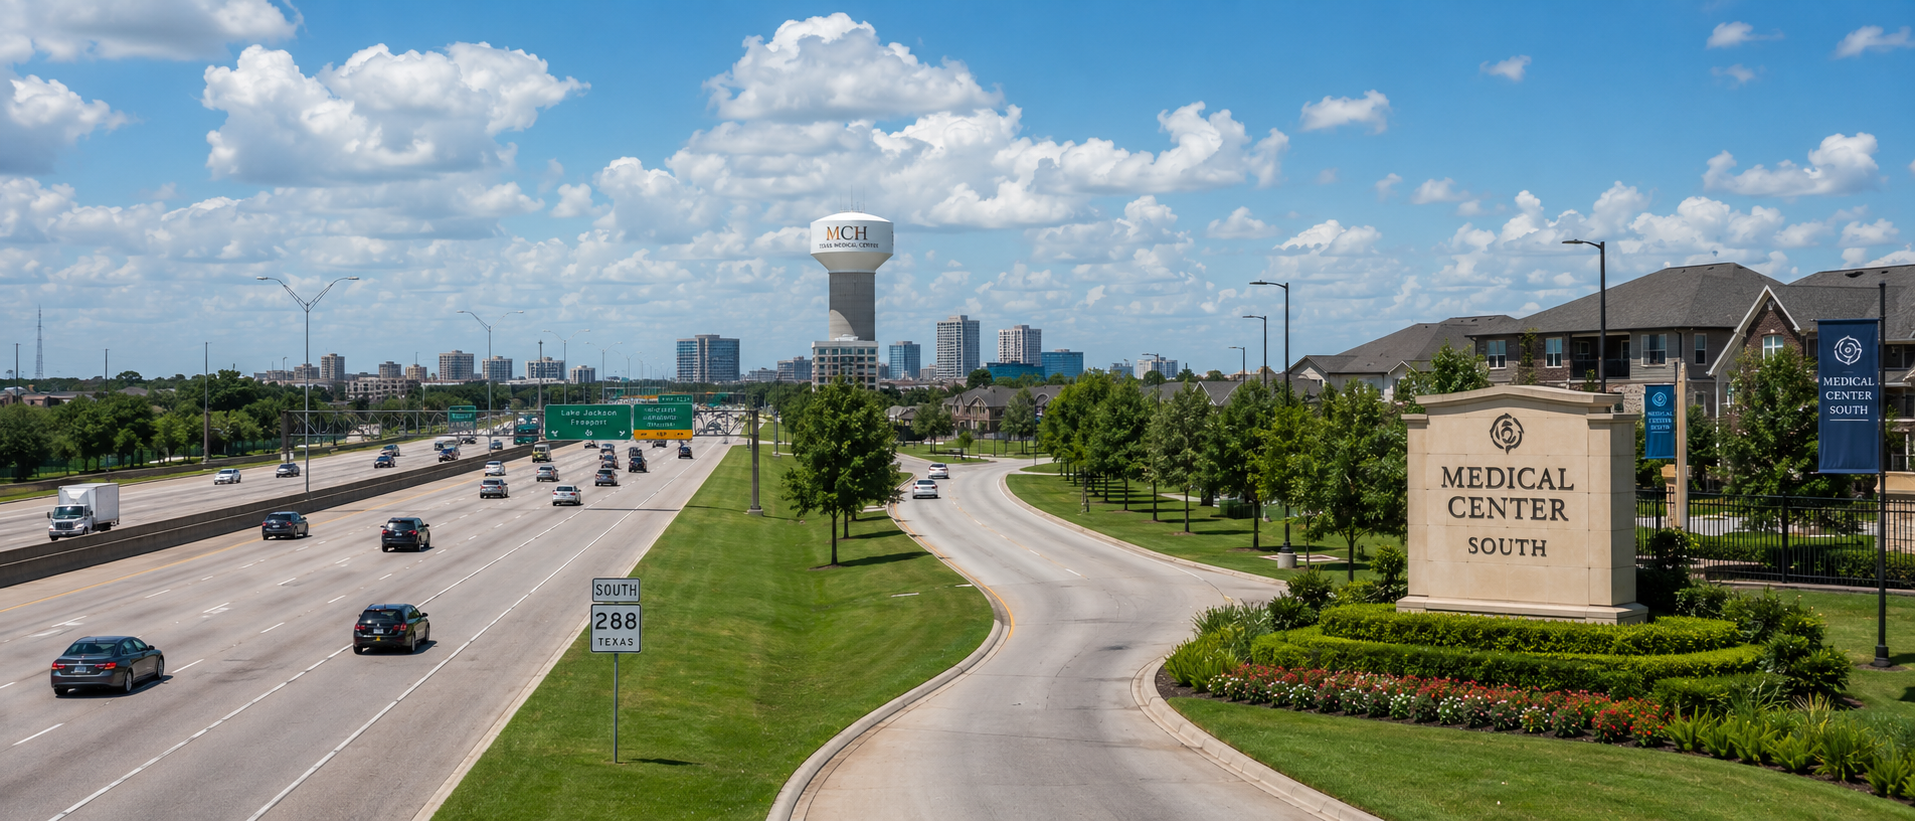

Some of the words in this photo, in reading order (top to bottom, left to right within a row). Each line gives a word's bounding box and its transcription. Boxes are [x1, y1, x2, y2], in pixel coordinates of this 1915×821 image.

[826, 225, 868, 240] MCH
[1823, 376, 1875, 387] MEDICAL
[1825, 390, 1873, 400] CENTER
[1829, 405, 1868, 415] SOUTH
[1440, 465, 1575, 491] MEDICAL
[1447, 495, 1570, 522] CENTER
[1467, 536, 1548, 557] SOUTH
[595, 583, 637, 597] SOUTH
[595, 612, 637, 630] 288
[597, 637, 634, 646] TEXAS
